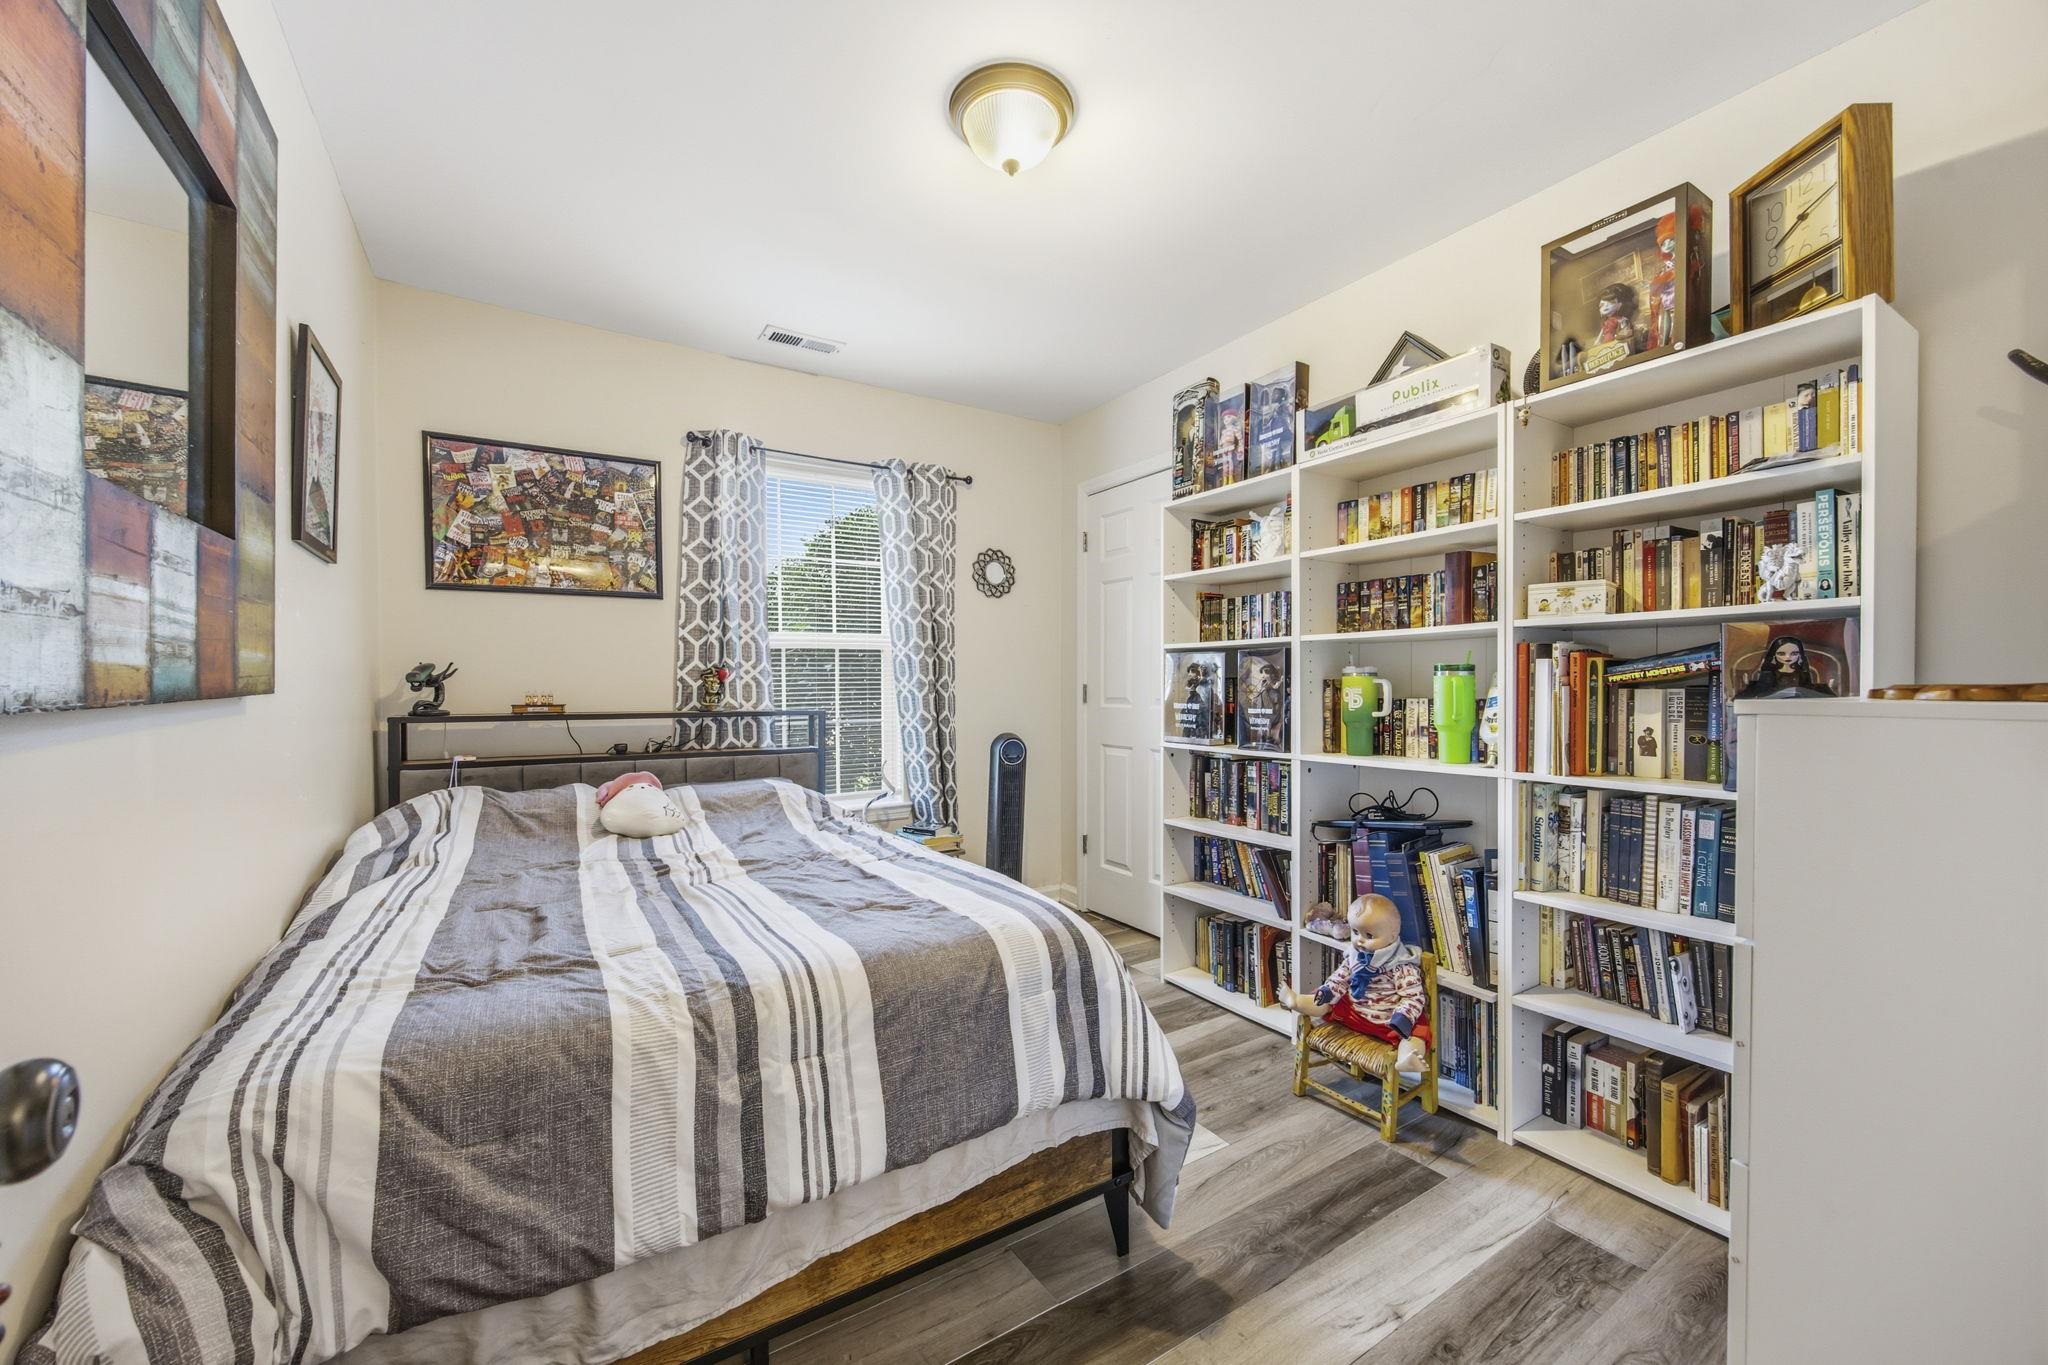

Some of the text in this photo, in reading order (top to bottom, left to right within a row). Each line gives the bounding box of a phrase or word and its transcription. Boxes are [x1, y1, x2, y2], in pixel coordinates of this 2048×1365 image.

[1798, 171, 1815, 197] 12
[1766, 201, 1783, 226] 10
[1766, 226, 1779, 247] 9
[1768, 247, 1779, 268] 8
[1784, 245, 1795, 266] 7
[1392, 378, 1439, 403] Publix
[1818, 494, 1831, 567] PERSEPOLIS
[1840, 520, 1853, 592] Valley of the Dolls
[1665, 807, 1674, 817] The
[1532, 816, 1544, 862] Storytime
[1663, 817, 1674, 839] Burglary
[1696, 856, 1707, 887] CHING
[1598, 946, 1611, 972] KOONTZ
[1654, 957, 1663, 981] ZOMBIE
[1544, 1075, 1552, 1105] Blackout
